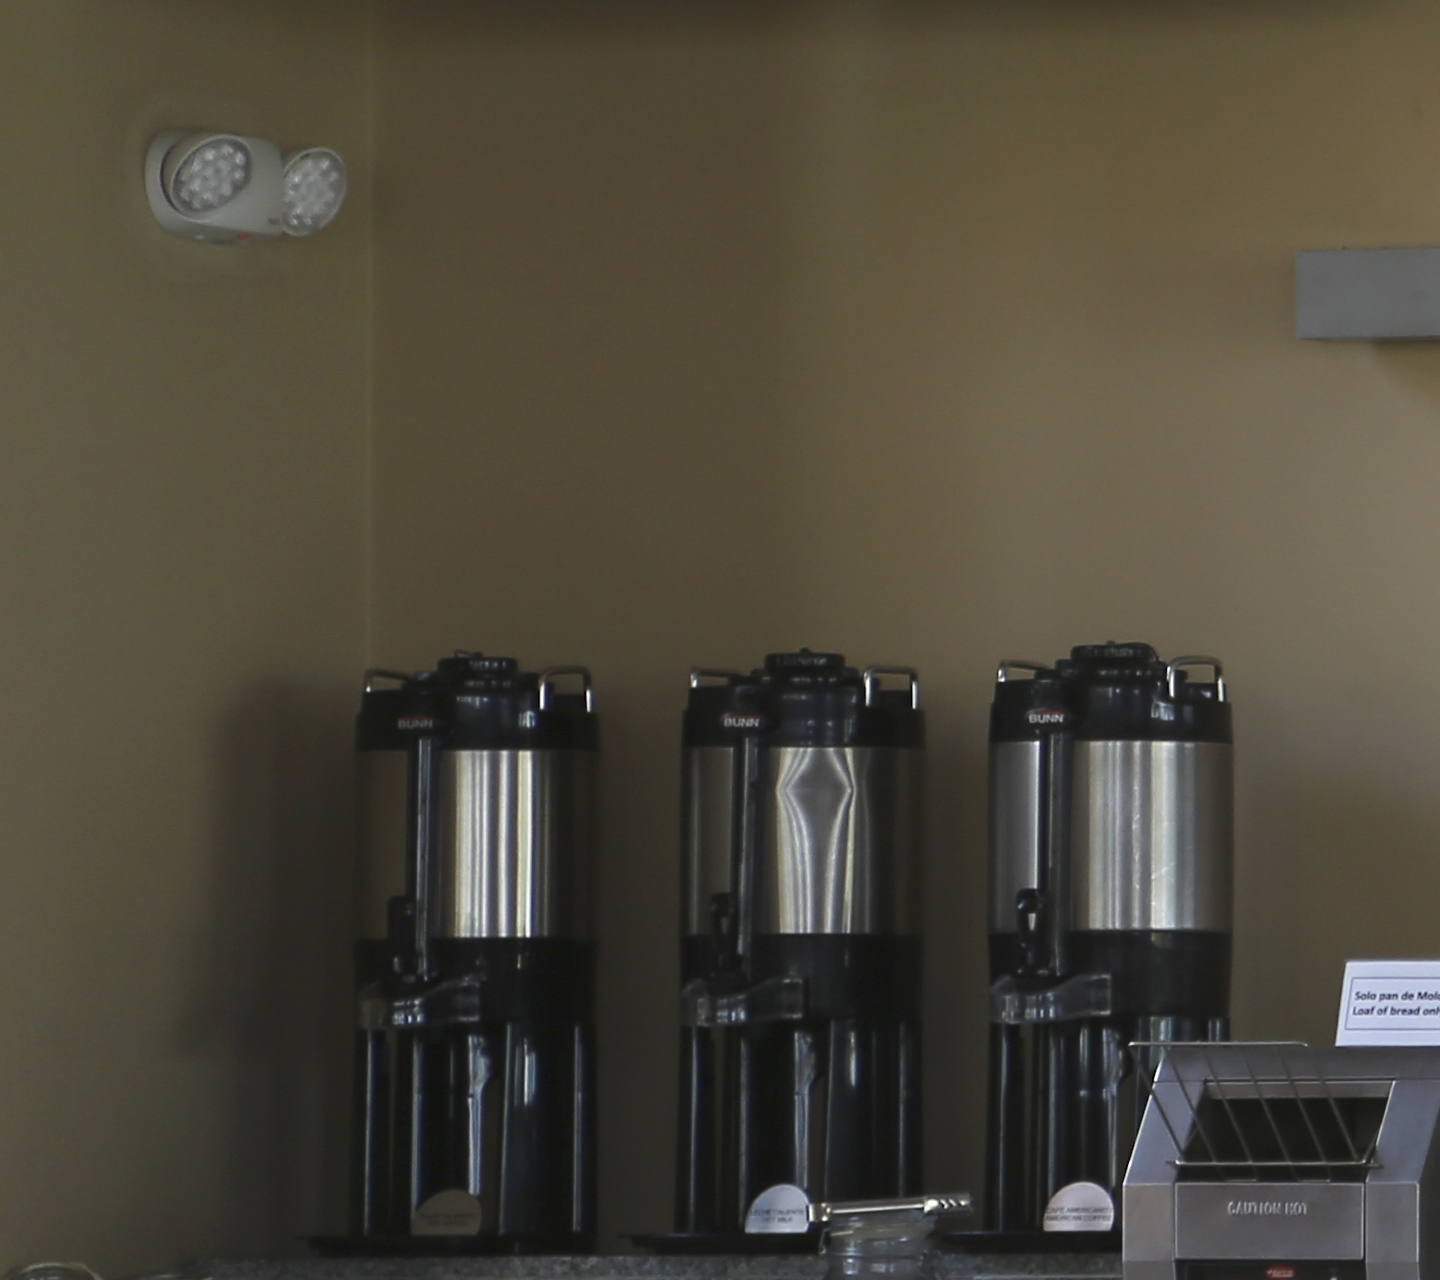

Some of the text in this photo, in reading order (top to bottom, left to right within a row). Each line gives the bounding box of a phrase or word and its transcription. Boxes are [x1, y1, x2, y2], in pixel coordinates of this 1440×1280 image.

[398, 718, 433, 729] BUNN
[724, 718, 760, 727] BUNN
[1029, 713, 1065, 724] BUNN
[1354, 991, 1377, 1001] Solo
[1378, 993, 1398, 1003] pan
[1401, 991, 1415, 1001] de
[1352, 1006, 1375, 1016] Loaf
[1376, 1006, 1388, 1016] of
[1389, 1006, 1420, 1016] bread
[1227, 1201, 1307, 1215] CAUTION HOT
